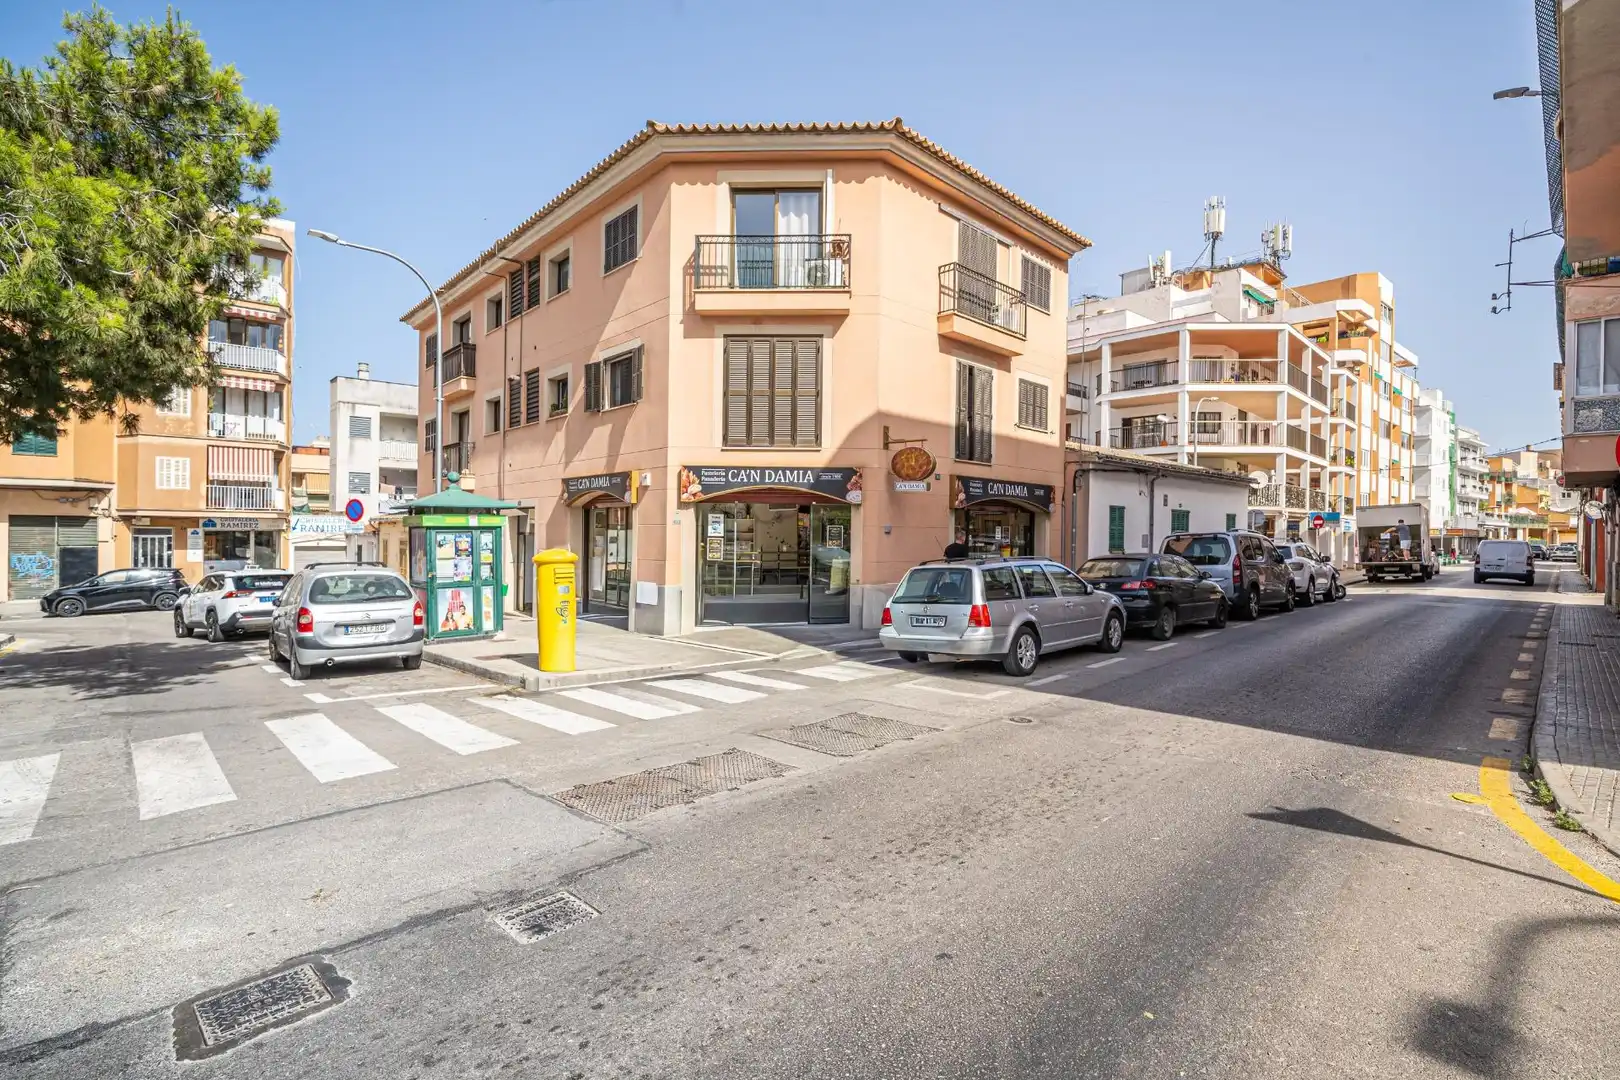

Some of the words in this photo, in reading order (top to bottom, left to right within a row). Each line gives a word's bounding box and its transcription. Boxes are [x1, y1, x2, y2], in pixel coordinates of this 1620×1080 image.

[728, 469, 760, 483] CA'N
[765, 470, 814, 483] DAMIA
[988, 482, 1005, 495] CA'N
[1005, 484, 1028, 497] DAMIA
[300, 524, 345, 533] RAMIRE
